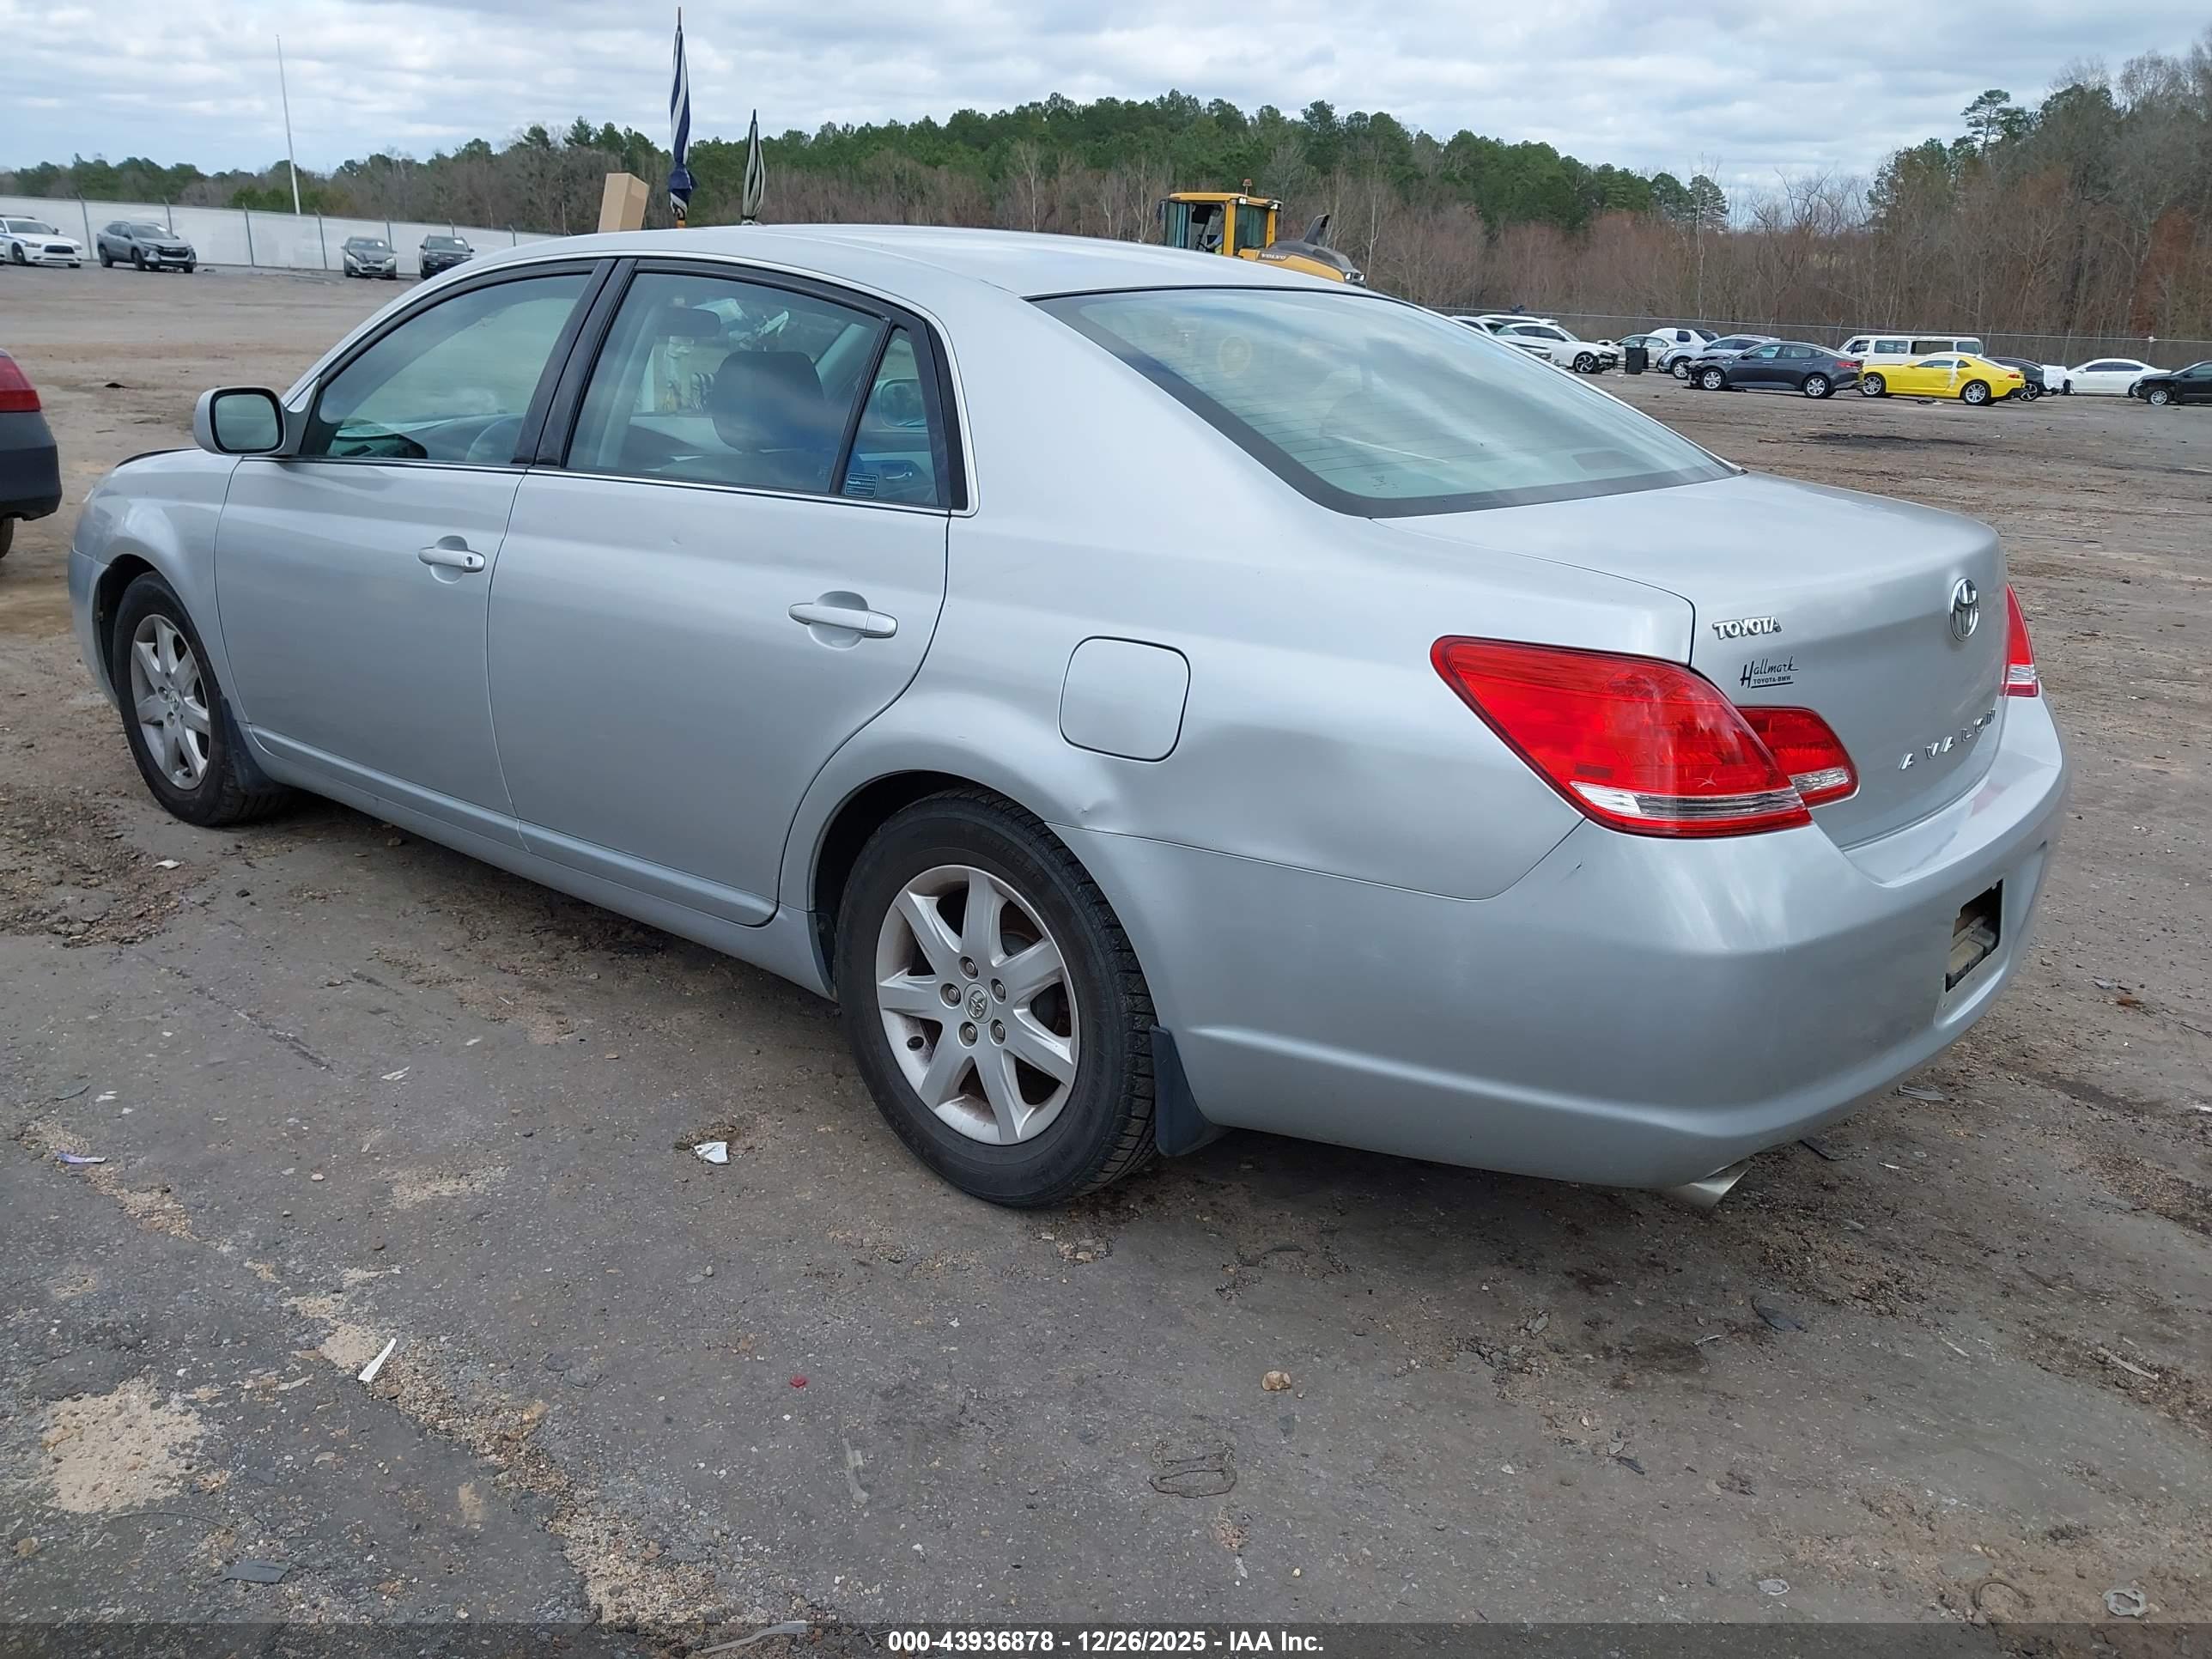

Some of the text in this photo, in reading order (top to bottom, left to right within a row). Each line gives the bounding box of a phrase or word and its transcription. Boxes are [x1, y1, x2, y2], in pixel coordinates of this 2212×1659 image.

[1712, 617, 1783, 640] TOYOTA
[1740, 655, 1800, 689] Hallmark
[1753, 675, 1792, 684] TOYOTA-BMW
[1898, 708, 1996, 770] AVALON
